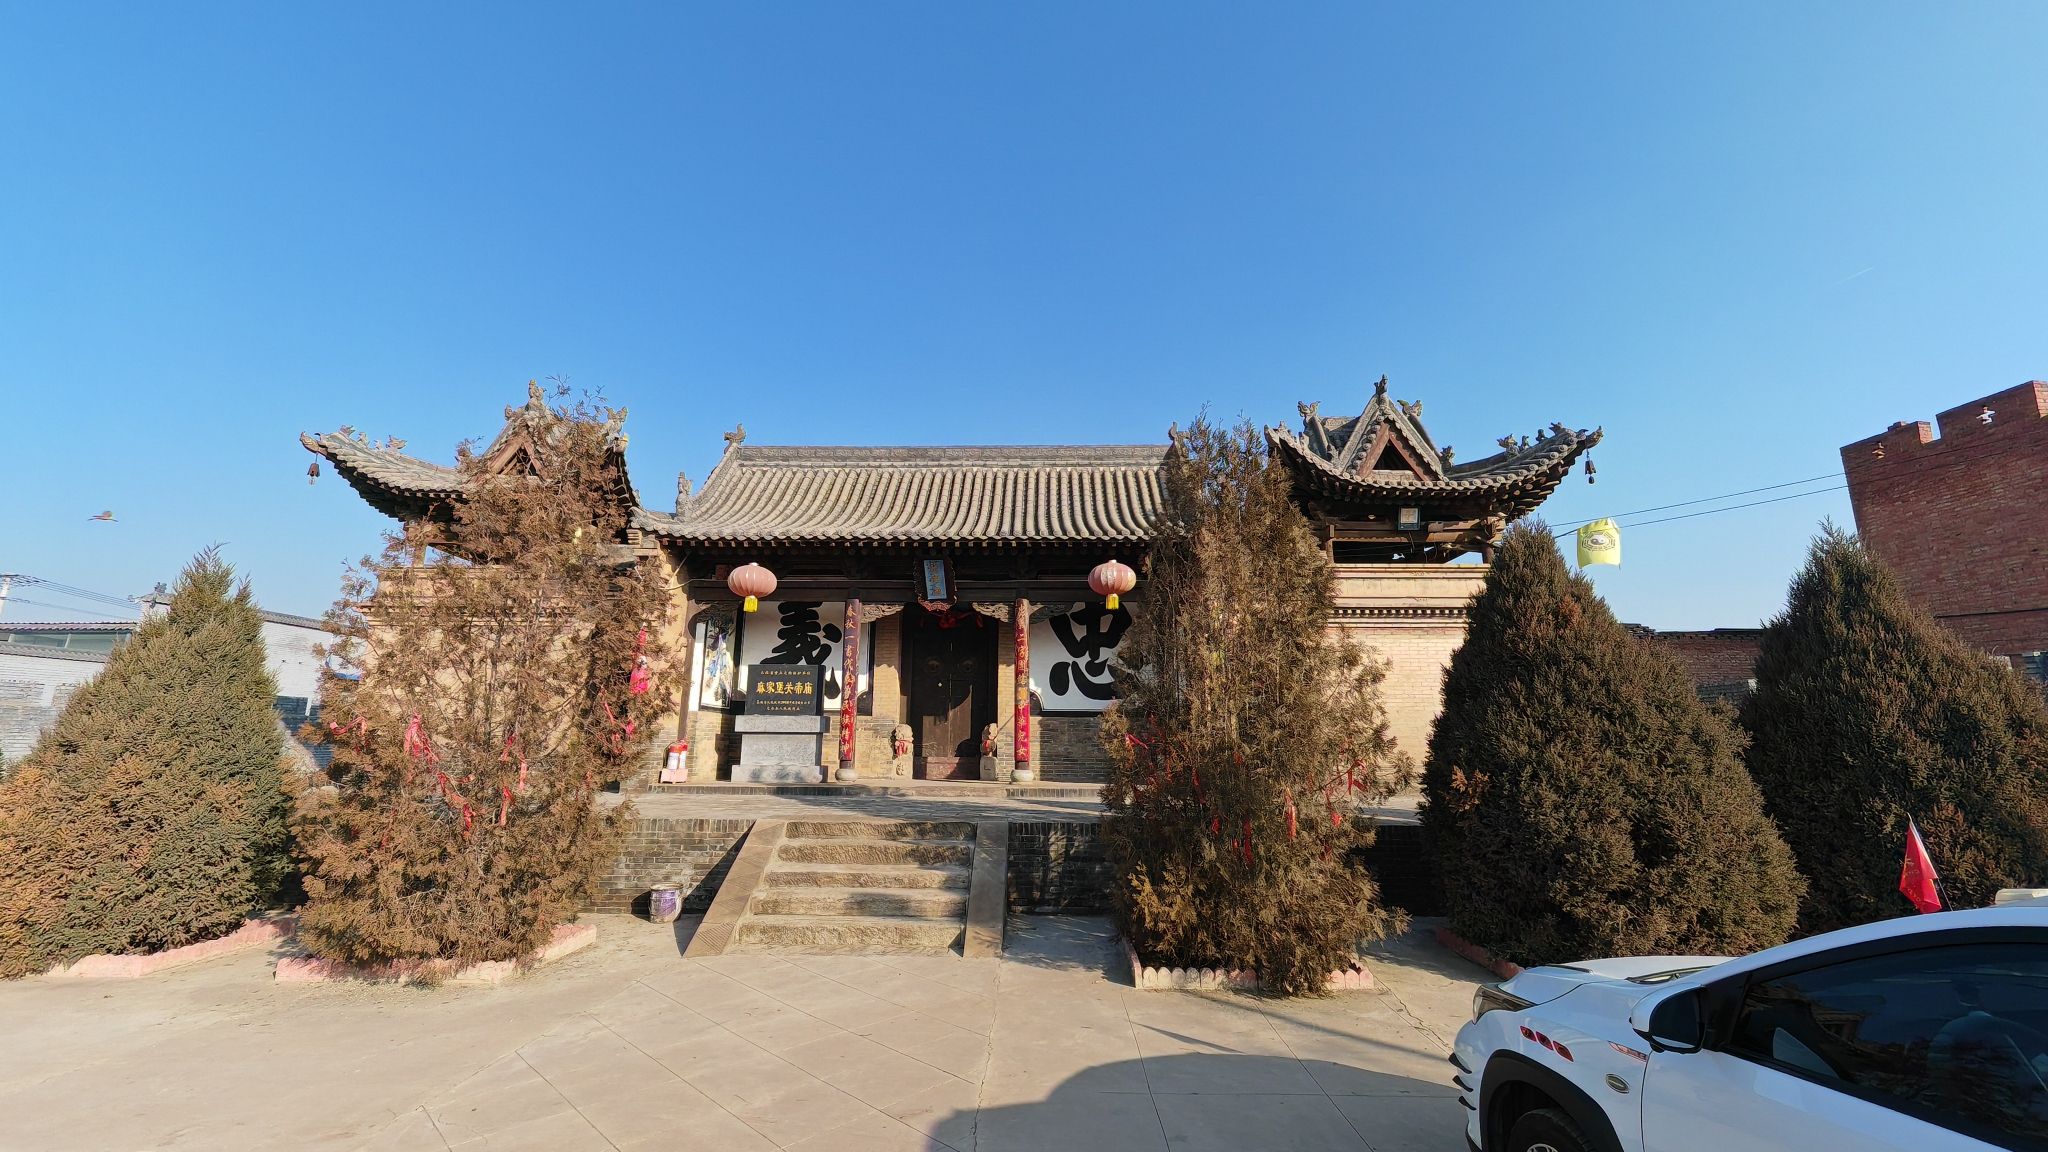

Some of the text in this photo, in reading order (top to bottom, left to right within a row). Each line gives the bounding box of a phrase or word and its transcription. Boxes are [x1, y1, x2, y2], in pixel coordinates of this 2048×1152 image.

[1049, 602, 1133, 700] 忠
[756, 681, 813, 695] 麻家堡关帝庙
